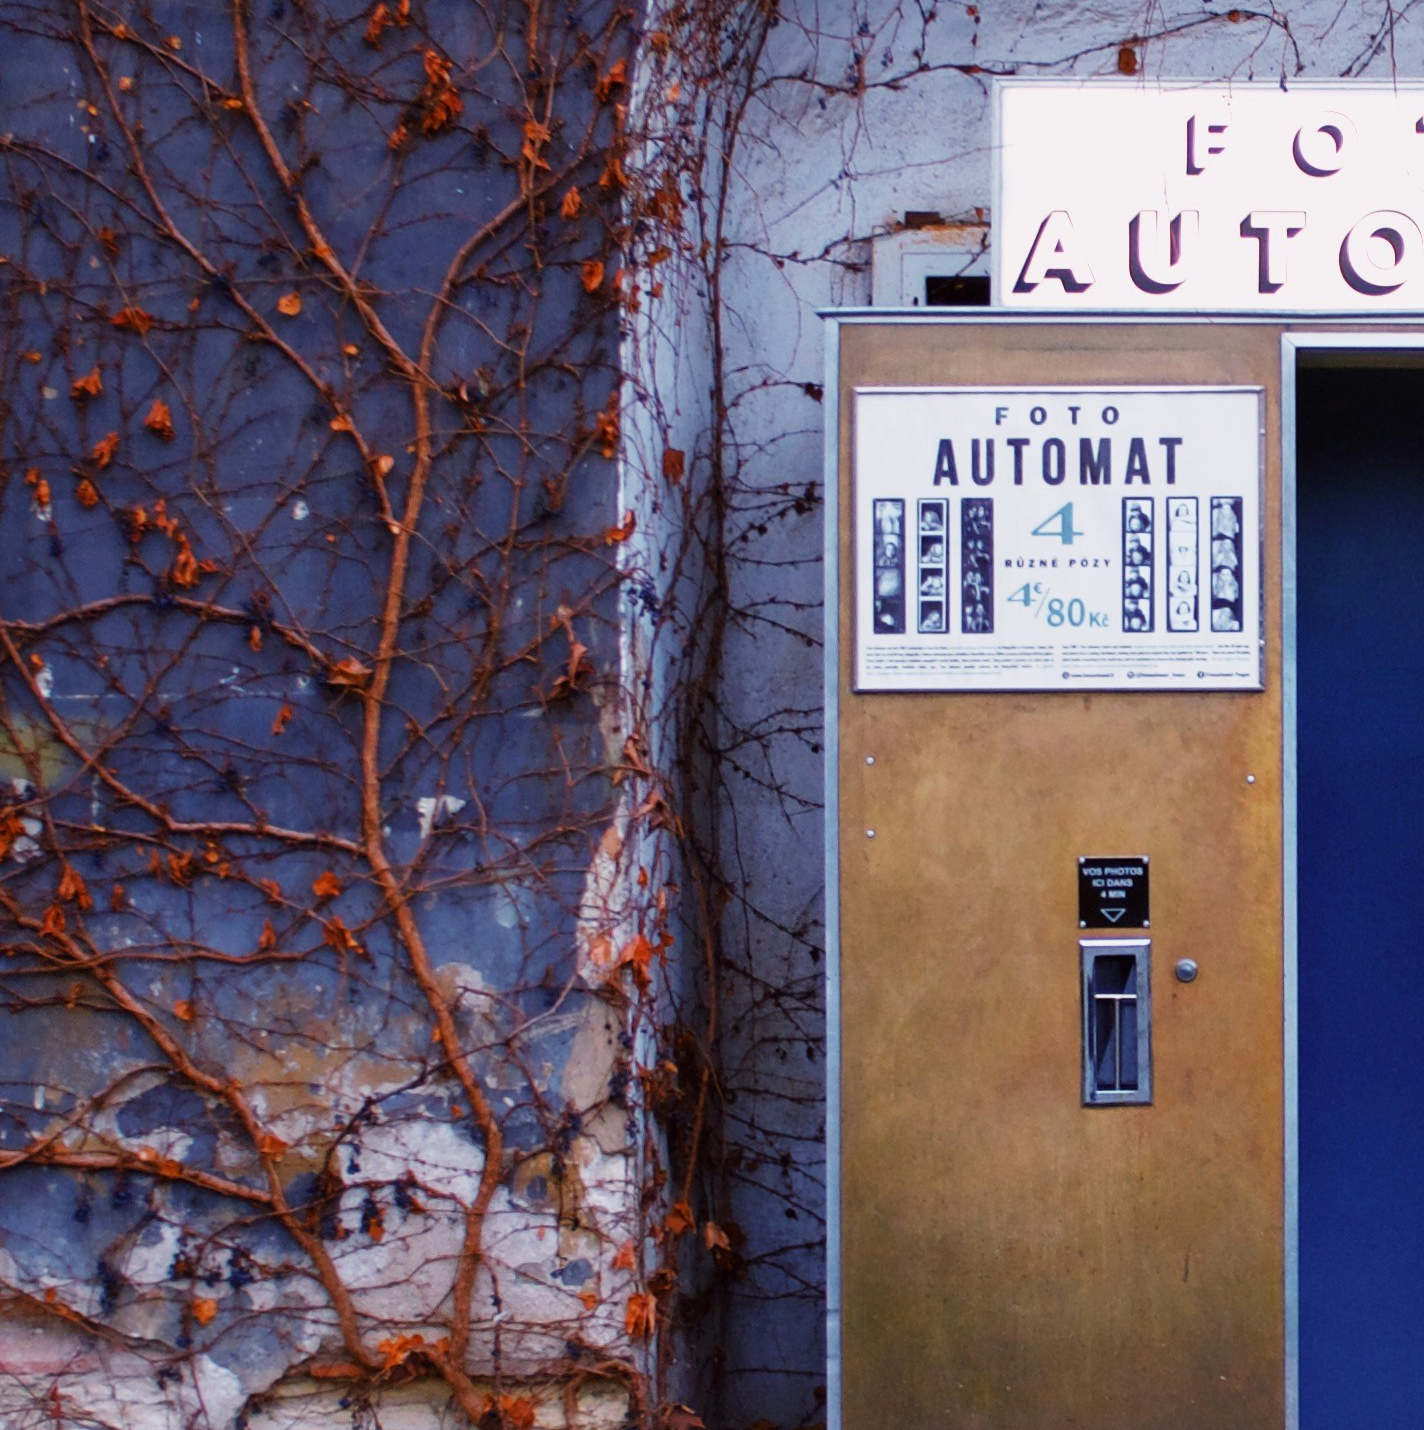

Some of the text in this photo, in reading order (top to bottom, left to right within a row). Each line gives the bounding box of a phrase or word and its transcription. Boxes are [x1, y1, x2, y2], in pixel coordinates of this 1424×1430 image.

[994, 405, 1120, 427] FOTO
[932, 436, 1184, 487] AUTOMAT
[1030, 501, 1085, 546] 4
[1082, 867, 1143, 876] VOS PHOTOS
[1106, 878, 1133, 887] DANS
